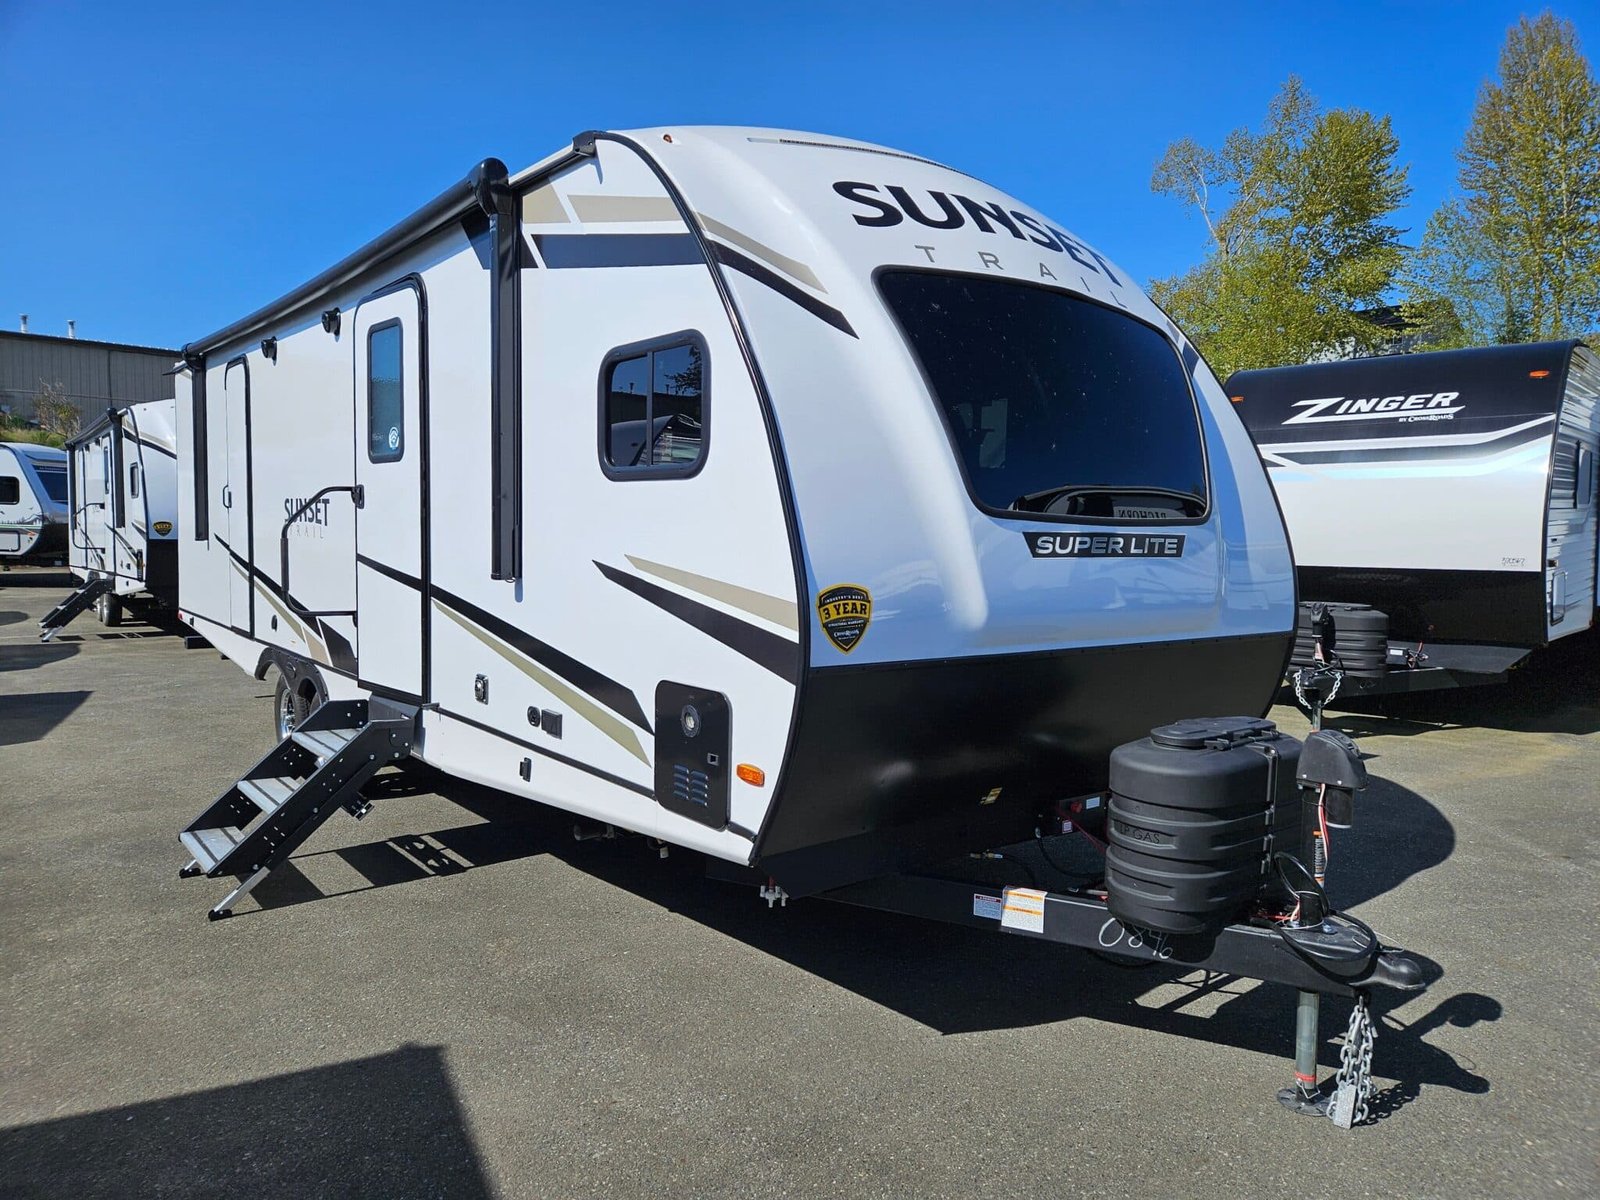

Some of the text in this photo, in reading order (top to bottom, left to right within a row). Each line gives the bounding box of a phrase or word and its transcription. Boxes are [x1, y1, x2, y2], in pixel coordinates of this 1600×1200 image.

[832, 180, 1123, 288] SUNSET
[914, 244, 1128, 309] TRAIL
[1281, 391, 1466, 425] ZINGER
[1035, 535, 1179, 555] SUPER LITE
[823, 602, 868, 620] 3 YEAR
[1132, 829, 1160, 845] GAS
